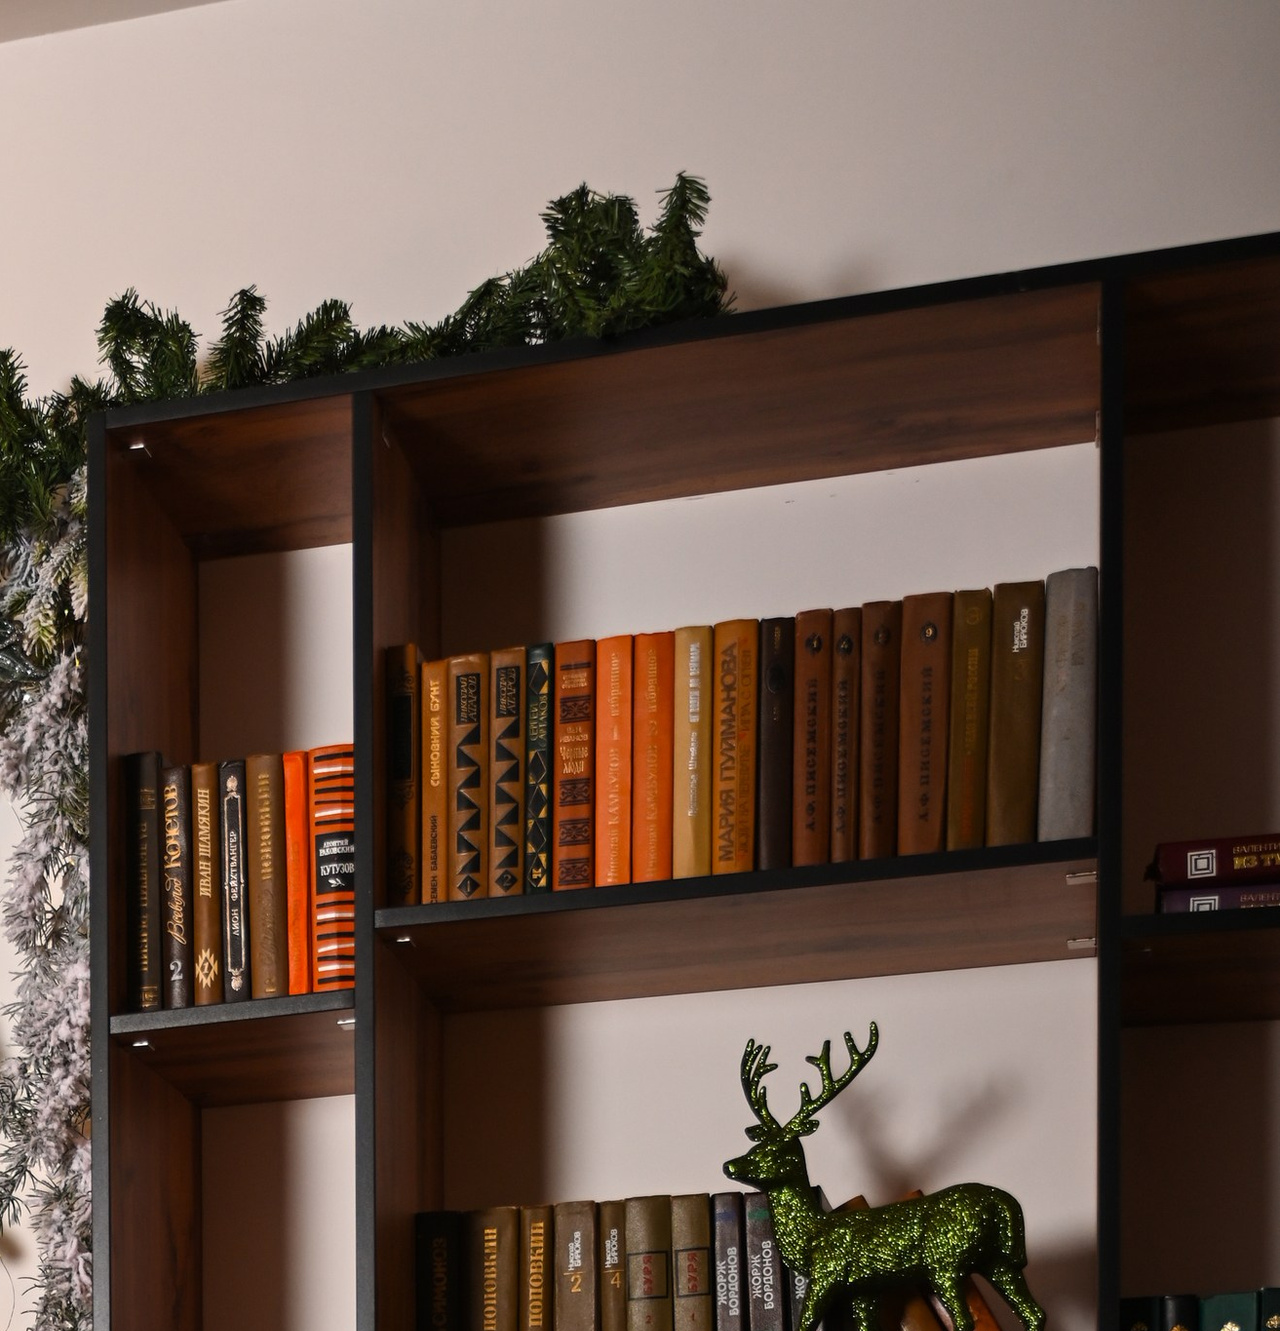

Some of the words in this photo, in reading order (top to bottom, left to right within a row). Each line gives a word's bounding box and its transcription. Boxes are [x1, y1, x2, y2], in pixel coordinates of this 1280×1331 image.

[1020, 609, 1029, 648] БИРЮКОВ
[429, 680, 441, 712] БУНТ
[460, 676, 469, 723] НИКОЛАЙ
[468, 675, 478, 721] АТАРОВ
[499, 668, 508, 715] НИКОЛАЙ
[507, 666, 517, 714] АТАРОВ
[720, 641, 738, 782] ПУЙМАНОВА
[803, 678, 818, 796] ПИСЕМСКИЙ
[836, 679, 848, 799] ПИСЕМСКИЙ
[920, 666, 933, 786] ПИСЕМСКИЙ
[429, 717, 441, 788] СЫНОВНИЙ
[163, 783, 182, 869] КОЧЕТОВ
[197, 788, 211, 858] ШАМЯКИН
[429, 815, 439, 871] БАБАЕВСКИЙ
[718, 789, 734, 862] МАРИЯ
[199, 861, 212, 899] ИВАН
[229, 831, 239, 902] ФЕЙХТВАНГЕР
[320, 862, 355, 876] КУТУЗОВ
[502, 874, 511, 887] 2
[166, 873, 187, 945] Всеволод
[232, 908, 240, 937] ЛИОН
[170, 960, 183, 981] 2
[573, 1231, 582, 1267] БИРЮКОВ
[610, 1229, 618, 1266] БИРЮКОВ
[483, 1228, 498, 1331] ПОПОВКИН
[528, 1221, 544, 1327] ПОПОВКИН
[569, 1275, 583, 1293] 2
[610, 1271, 620, 1288] 4
[643, 1256, 653, 1295] БУРЯ
[688, 1253, 698, 1293] БУРЯ
[716, 1261, 727, 1305] ЖОРЖ
[727, 1247, 739, 1317] БОРДОНОВ
[752, 1255, 762, 1300] ЖОРЖ
[761, 1241, 773, 1310] БОРДОНОВ
